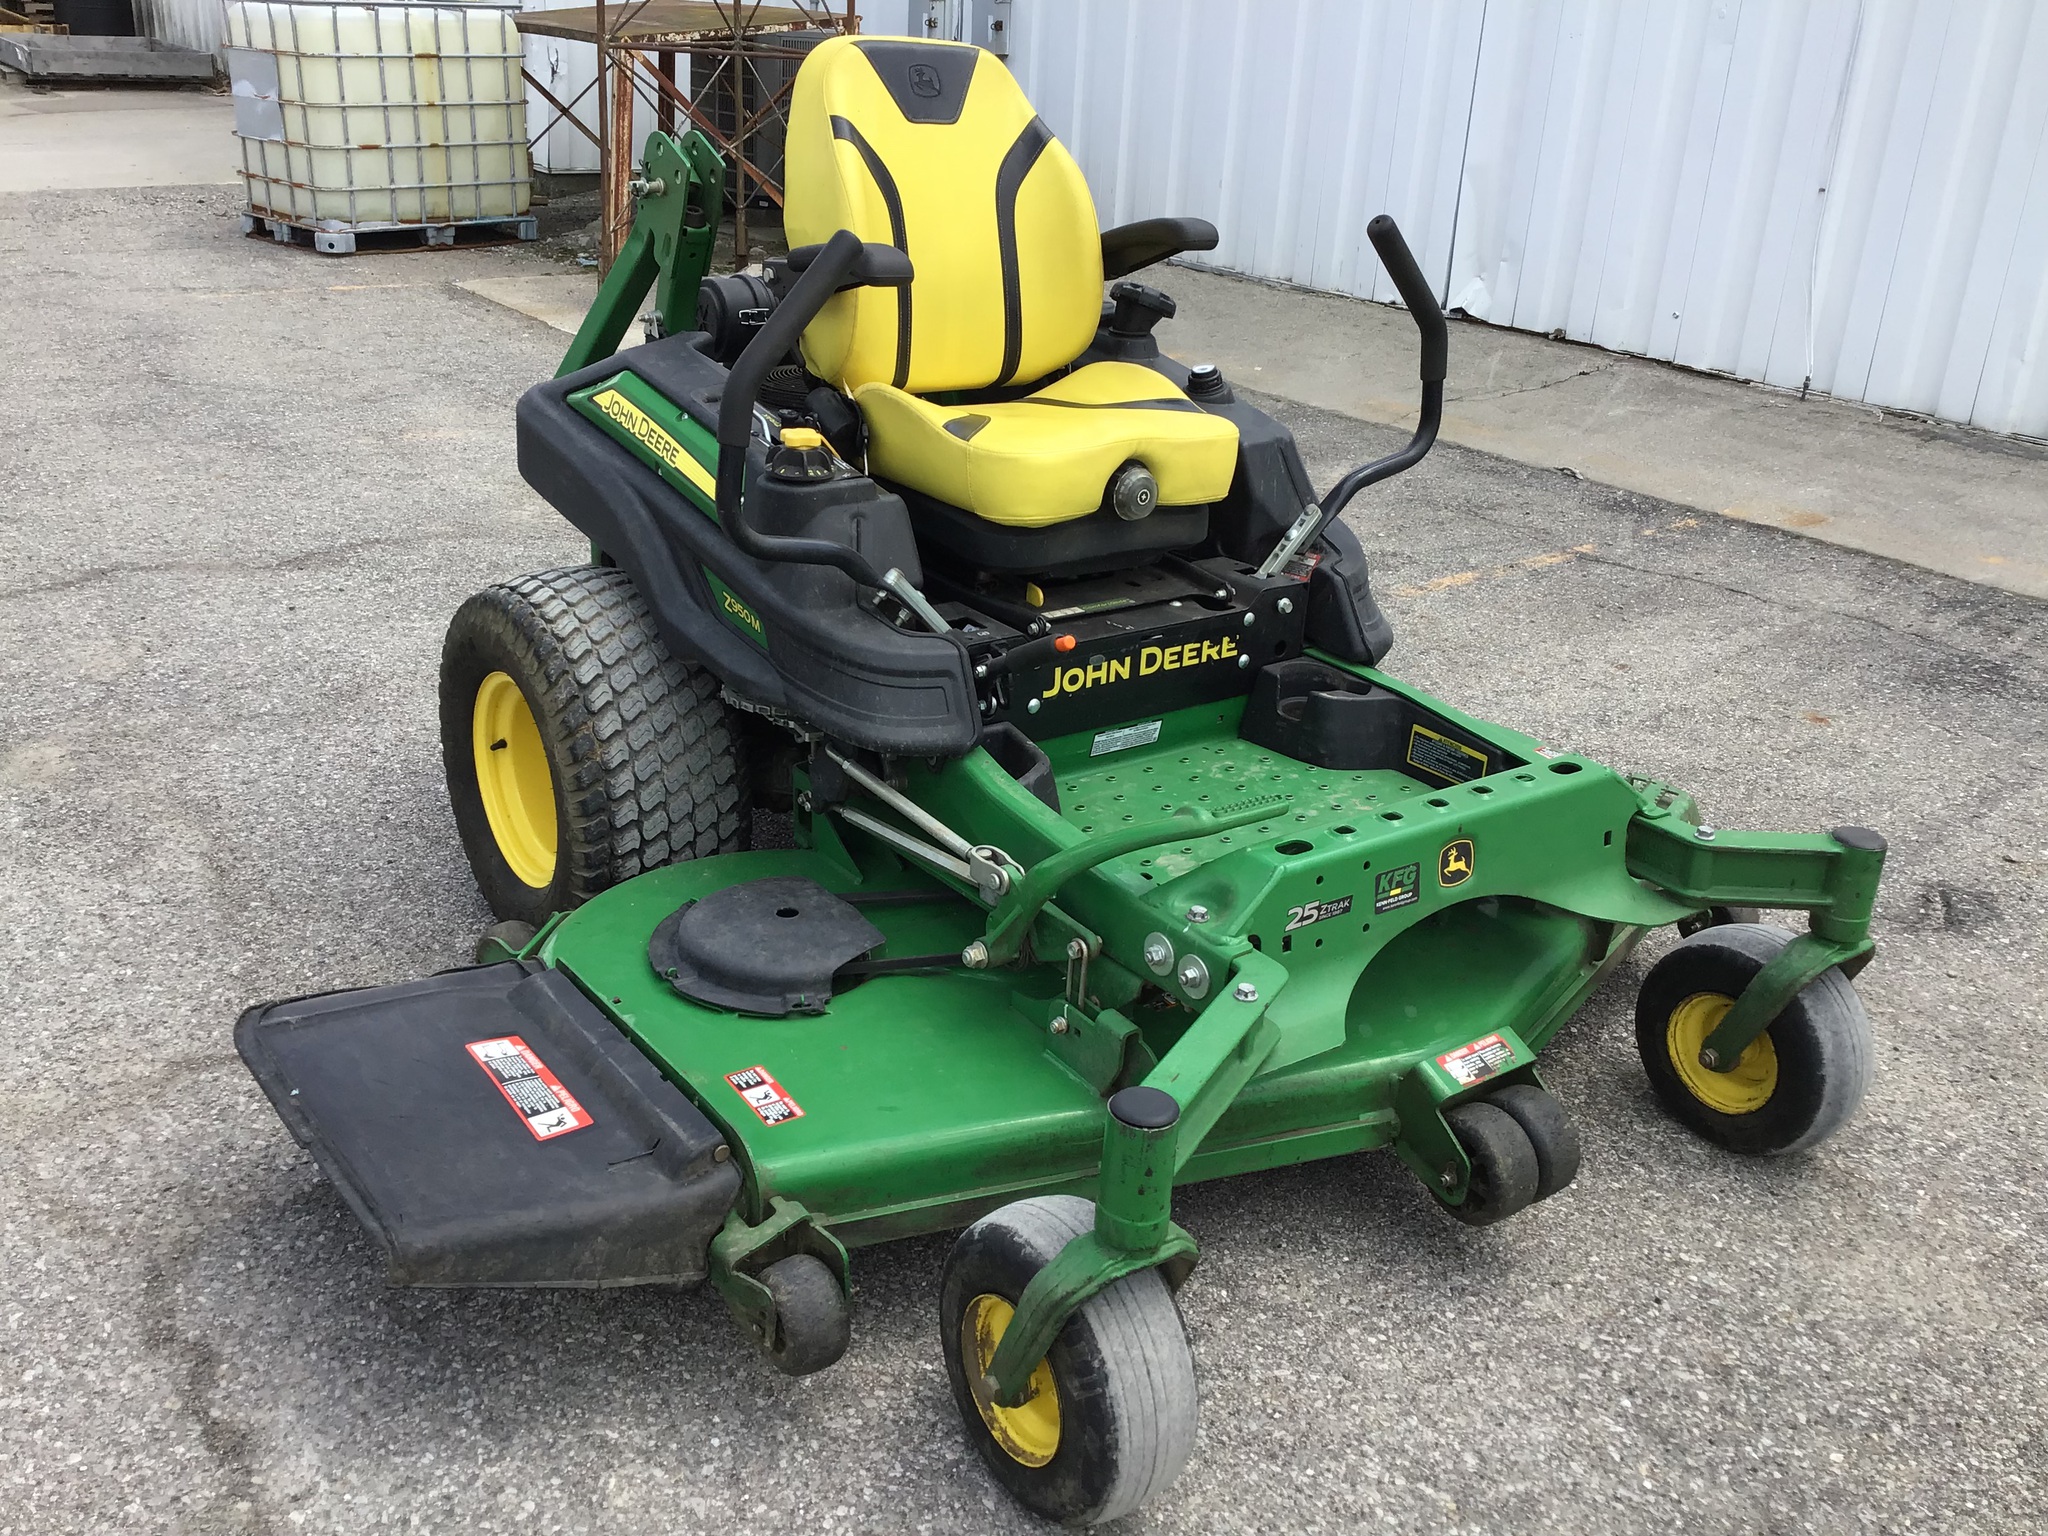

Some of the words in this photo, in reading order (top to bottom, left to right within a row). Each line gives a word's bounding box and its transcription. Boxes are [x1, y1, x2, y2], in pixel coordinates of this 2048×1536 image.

[602, 394, 638, 434] JOHN
[638, 417, 680, 465] DEERE
[723, 591, 761, 633] Z950M
[1042, 656, 1132, 698] JOHN
[1139, 634, 1240, 676] DEERE
[1378, 865, 1417, 893] KFG
[1285, 900, 1320, 932] 25
[1320, 899, 1350, 915] ZTRAK
[554, 1089, 582, 1113] PELIGRO
